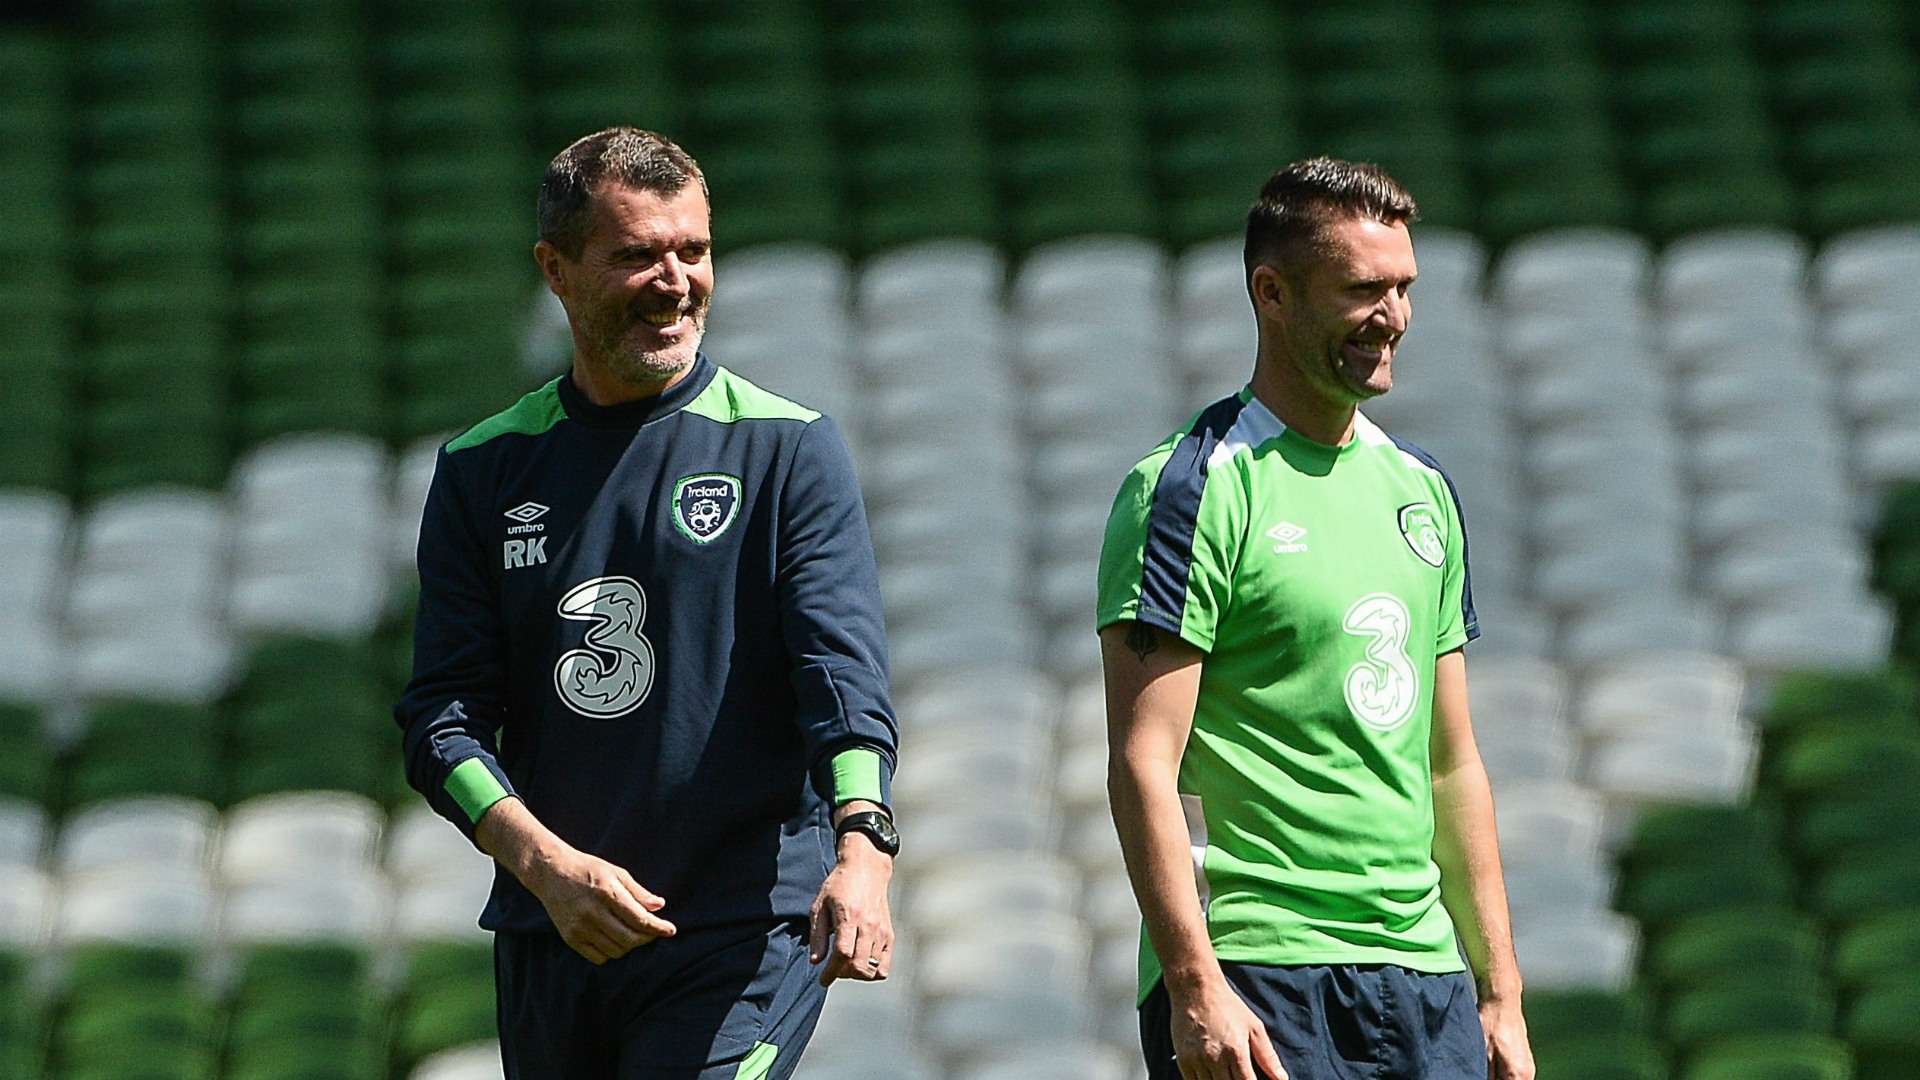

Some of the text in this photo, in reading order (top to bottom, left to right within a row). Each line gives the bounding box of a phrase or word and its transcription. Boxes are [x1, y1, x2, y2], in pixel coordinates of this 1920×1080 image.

[687, 485, 728, 498] Ireland
[507, 523, 545, 534] umbro
[504, 535, 548, 569] RK
[554, 576, 655, 718] 3
[1343, 593, 1419, 731] 3
